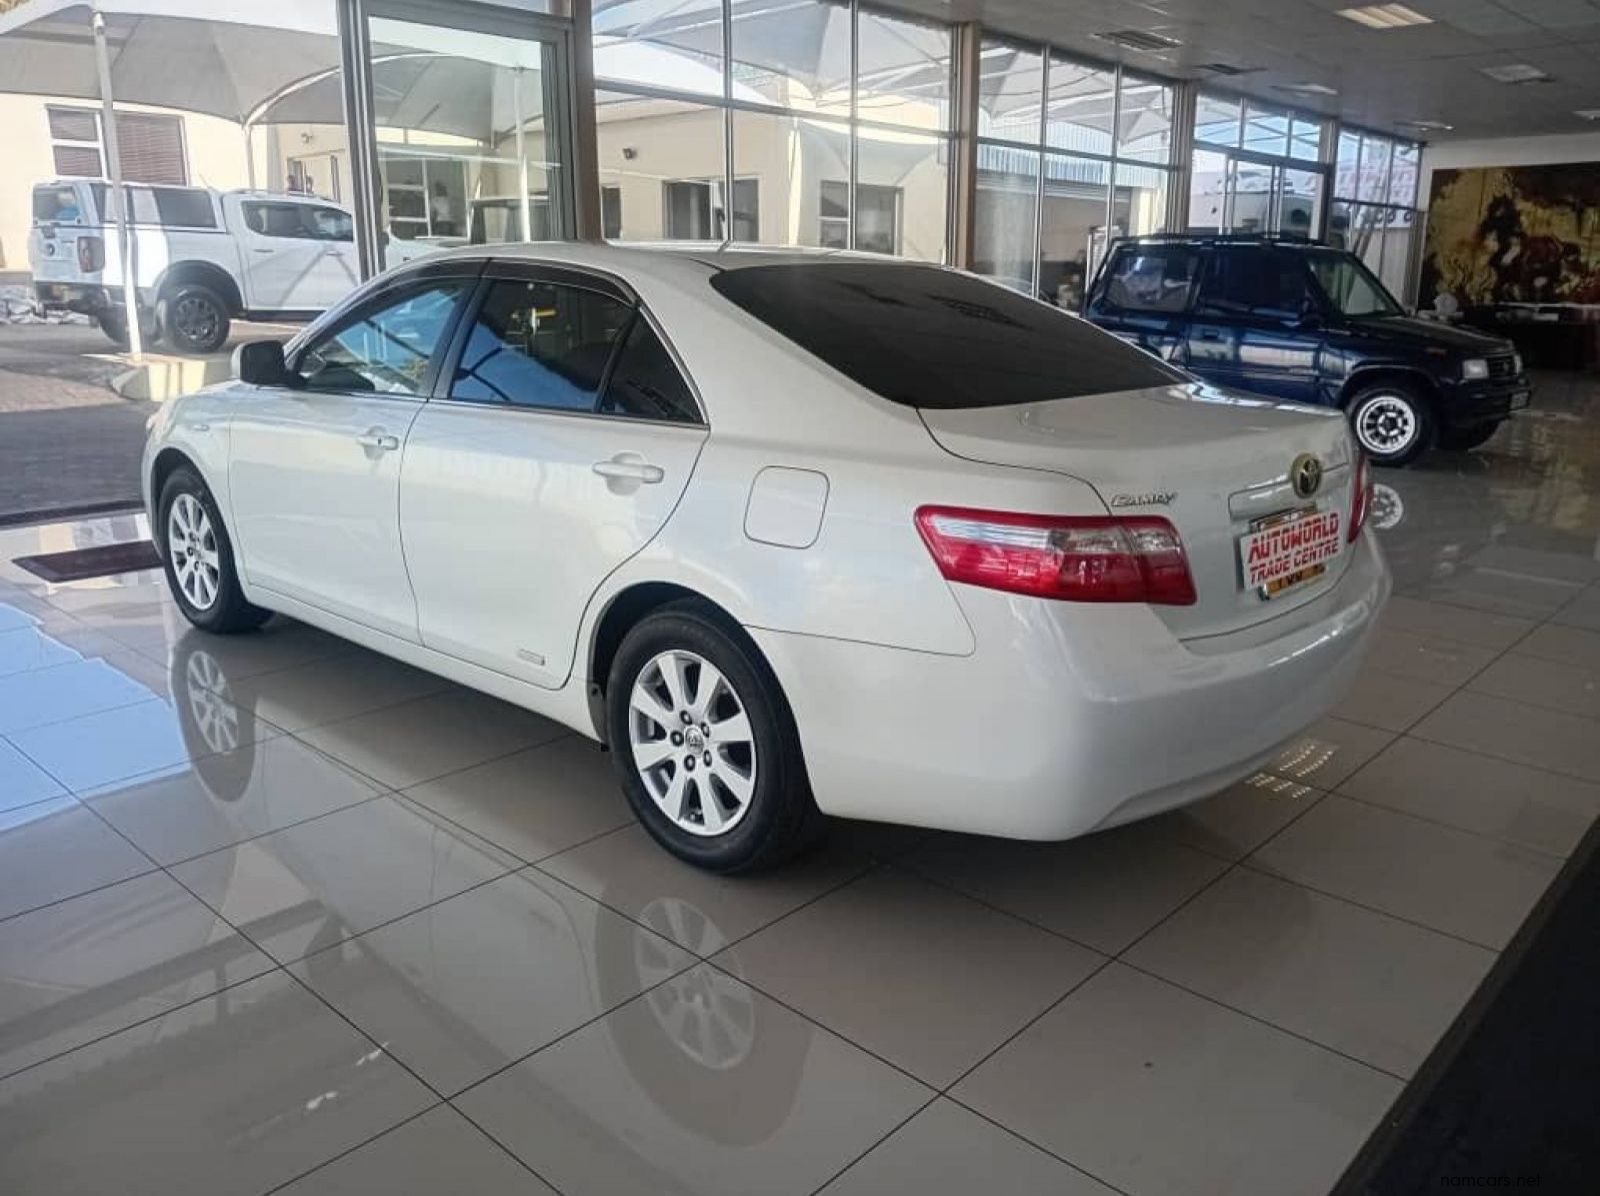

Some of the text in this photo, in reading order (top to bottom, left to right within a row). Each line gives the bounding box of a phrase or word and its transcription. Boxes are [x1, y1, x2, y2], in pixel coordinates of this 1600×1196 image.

[1248, 512, 1339, 563] AUTOWORLD
[1249, 554, 1291, 585] TRADE
[1294, 537, 1339, 567] CENTRE
